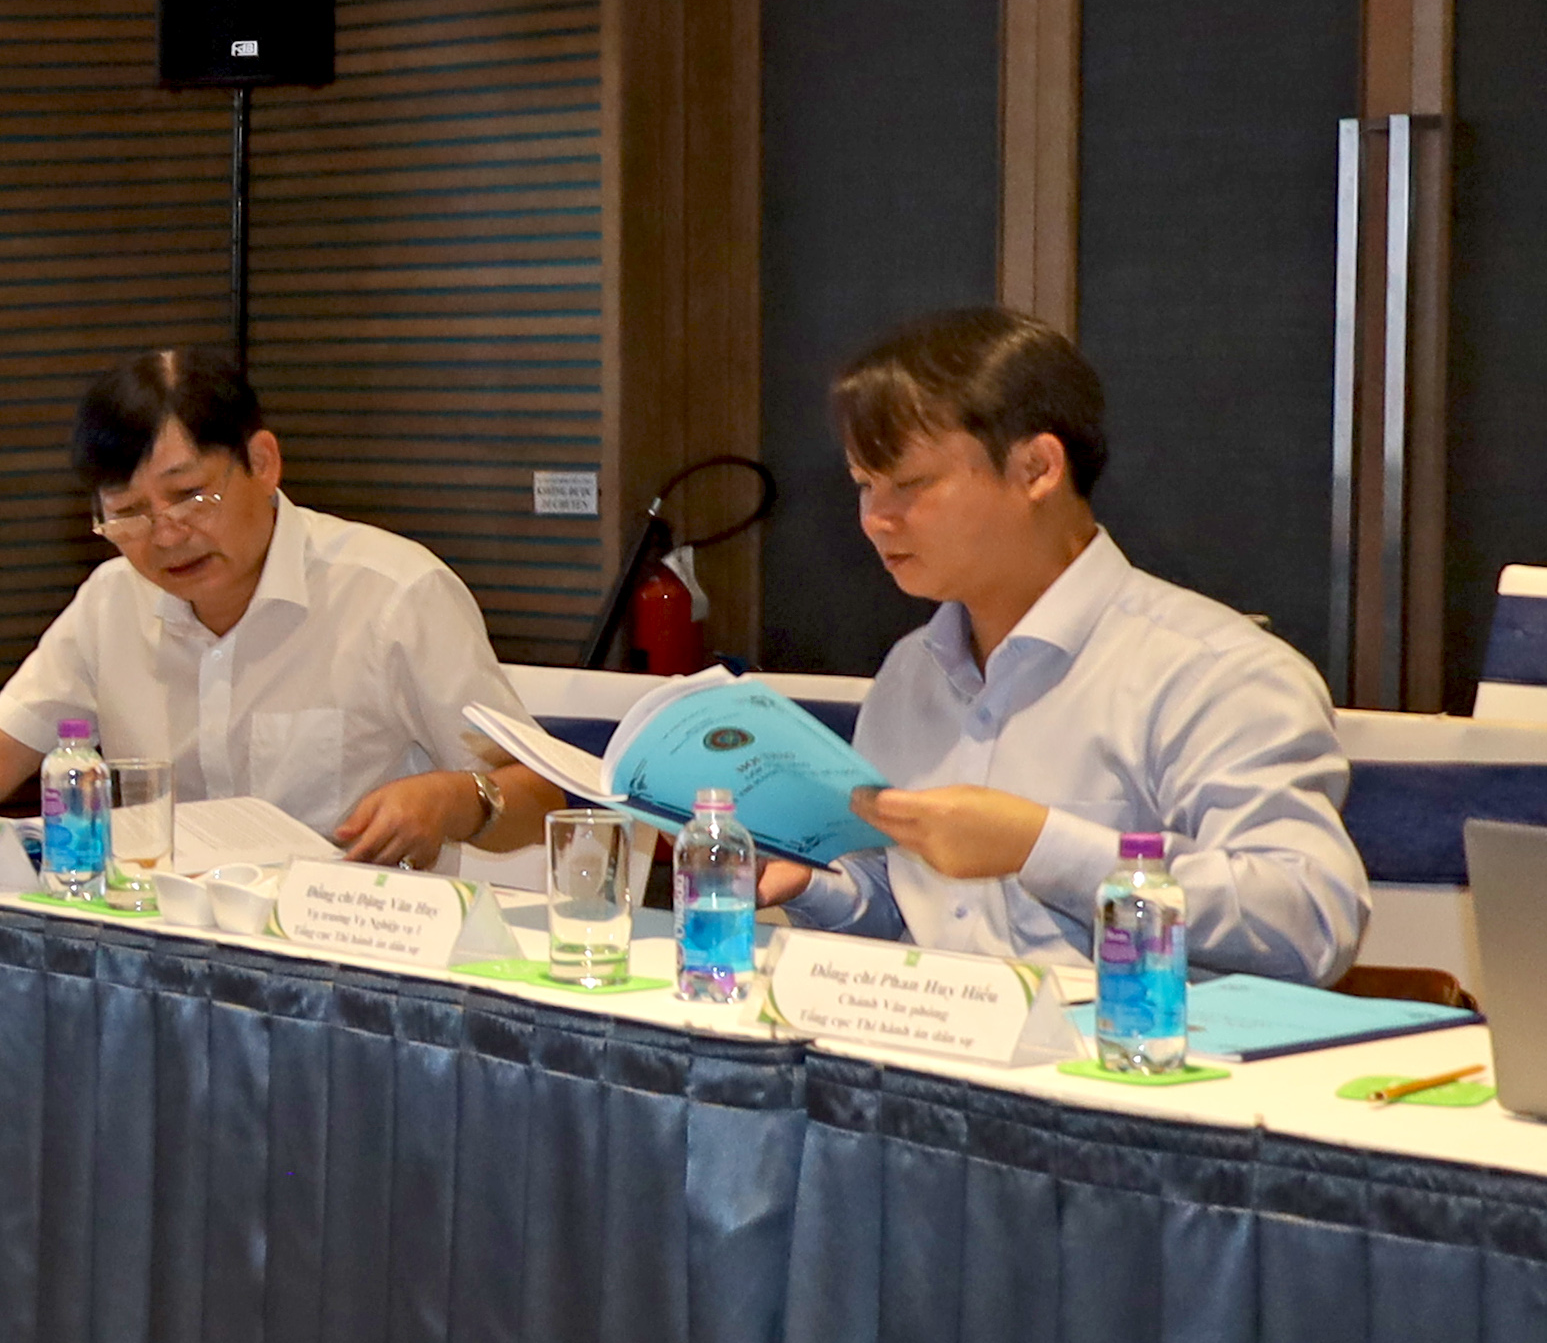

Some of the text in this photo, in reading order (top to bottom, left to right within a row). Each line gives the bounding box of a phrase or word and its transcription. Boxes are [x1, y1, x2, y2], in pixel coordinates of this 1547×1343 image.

[810, 961, 849, 985] Đồng
[880, 973, 919, 992] Phan
[923, 979, 955, 1001] Huy
